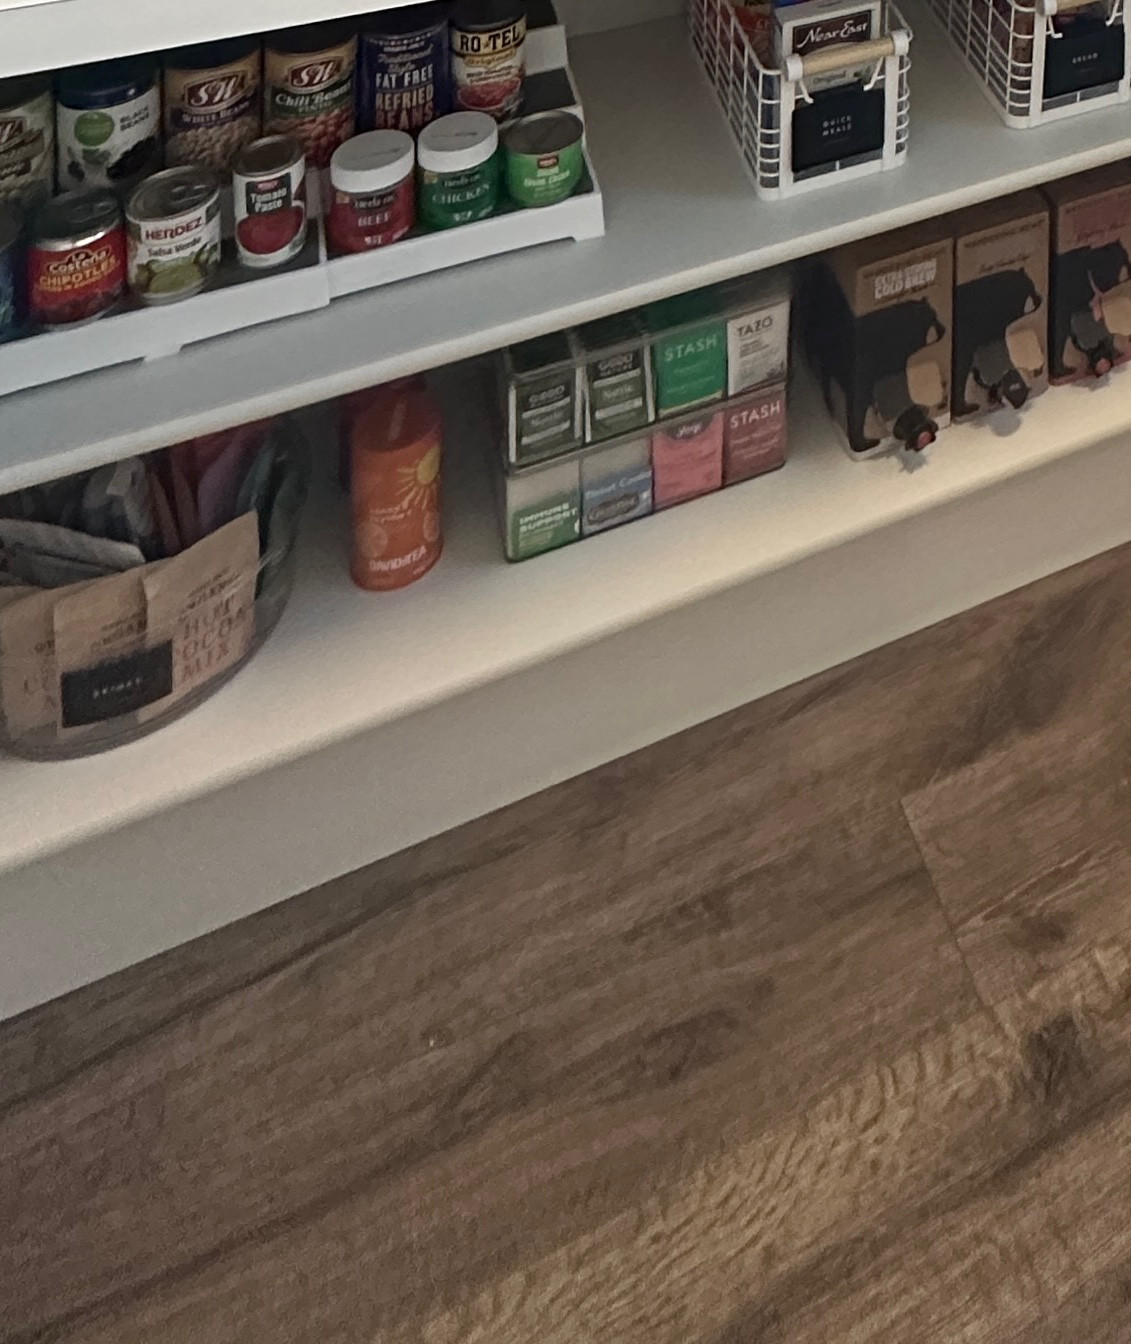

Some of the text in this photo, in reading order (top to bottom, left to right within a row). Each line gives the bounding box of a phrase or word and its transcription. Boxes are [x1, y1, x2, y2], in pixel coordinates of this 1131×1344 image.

[796, 19, 868, 49] Near East
[375, 63, 434, 89] FAT FREE
[275, 93, 310, 107] Chili
[375, 83, 434, 111] REFRIED
[120, 113, 150, 131] BEANS
[375, 101, 434, 130] BEANS
[822, 115, 851, 127] QUICK
[822, 123, 852, 136] MEALS
[250, 186, 288, 204] Tomato
[431, 183, 490, 205] CHICKEN
[254, 199, 283, 213] Paste
[145, 216, 202, 240] HERDEZ
[358, 212, 392, 227] BEEF
[148, 236, 202, 257] Salsa Verde
[874, 268, 937, 299] COLD BREW
[736, 315, 774, 338] TAZO
[664, 334, 719, 362] STASH
[729, 400, 781, 429] STASH
